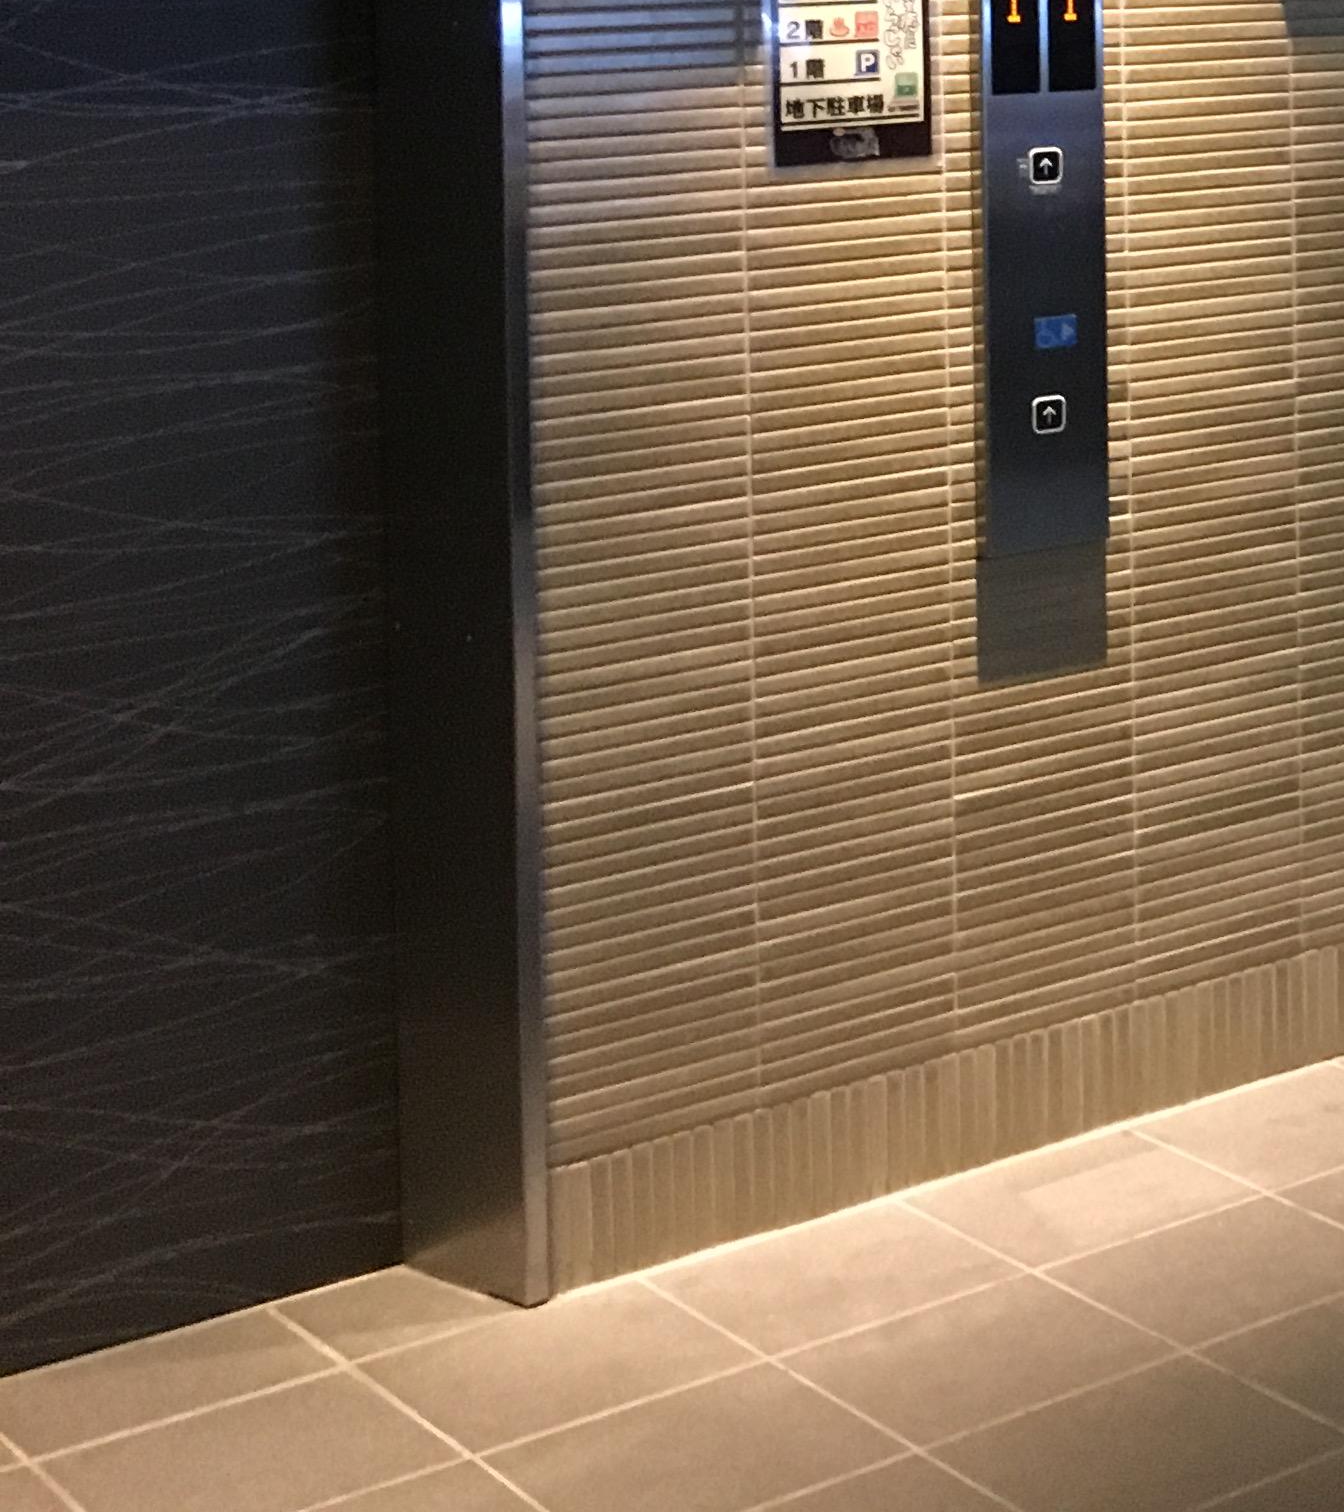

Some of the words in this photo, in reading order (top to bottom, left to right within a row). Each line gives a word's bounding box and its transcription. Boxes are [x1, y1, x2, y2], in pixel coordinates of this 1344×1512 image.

[785, 94, 885, 119] 地下駐車場
